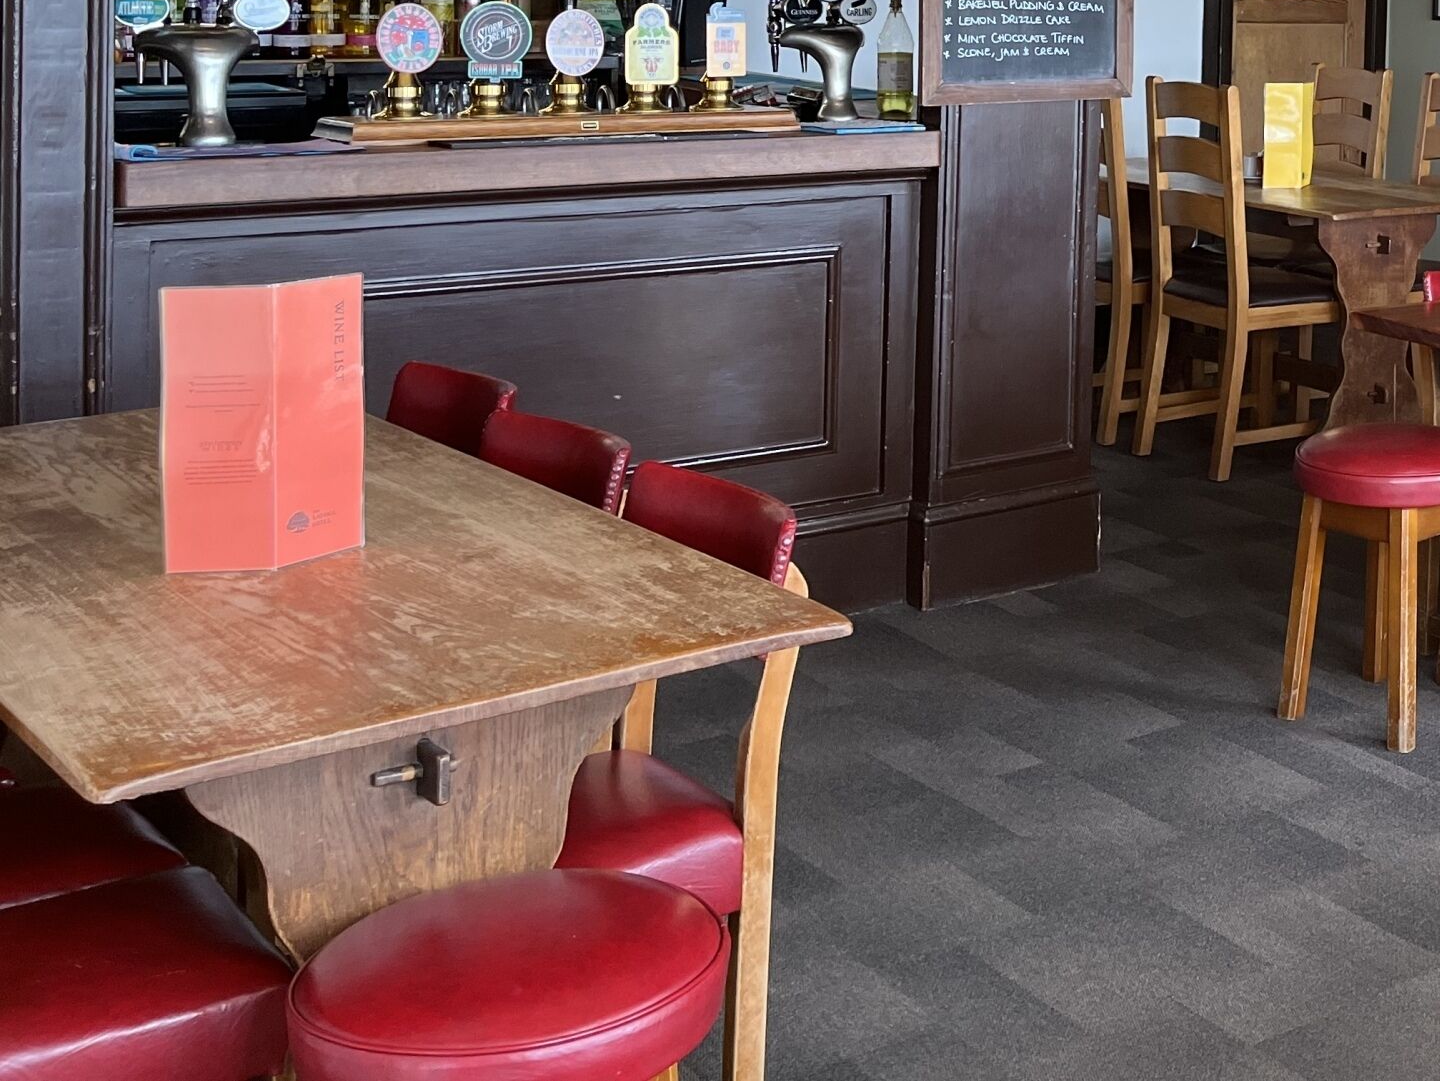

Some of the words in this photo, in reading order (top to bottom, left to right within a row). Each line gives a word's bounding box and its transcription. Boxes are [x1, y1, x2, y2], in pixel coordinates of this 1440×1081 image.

[790, 8, 818, 16] GUINNESS
[847, 7, 872, 17] CARLING
[958, 0, 1008, 10] BAKEWELL
[1009, 0, 1055, 10] PUDDING
[1068, 2, 1105, 13] CREAM
[958, 16, 996, 26] LEMON
[1001, 14, 1042, 25] DRIZZLE
[1046, 15, 1071, 25] CAKE
[477, 20, 503, 47] STORM
[481, 24, 518, 53] BREWING
[958, 34, 986, 44] MINT
[991, 32, 1048, 43] CHOCOLATE
[1051, 32, 1084, 44] TIFFIN
[995, 47, 1020, 61] JAM
[1035, 47, 1069, 57] CREAM
[334, 299, 344, 345] WINE
[334, 350, 344, 381] LIST
